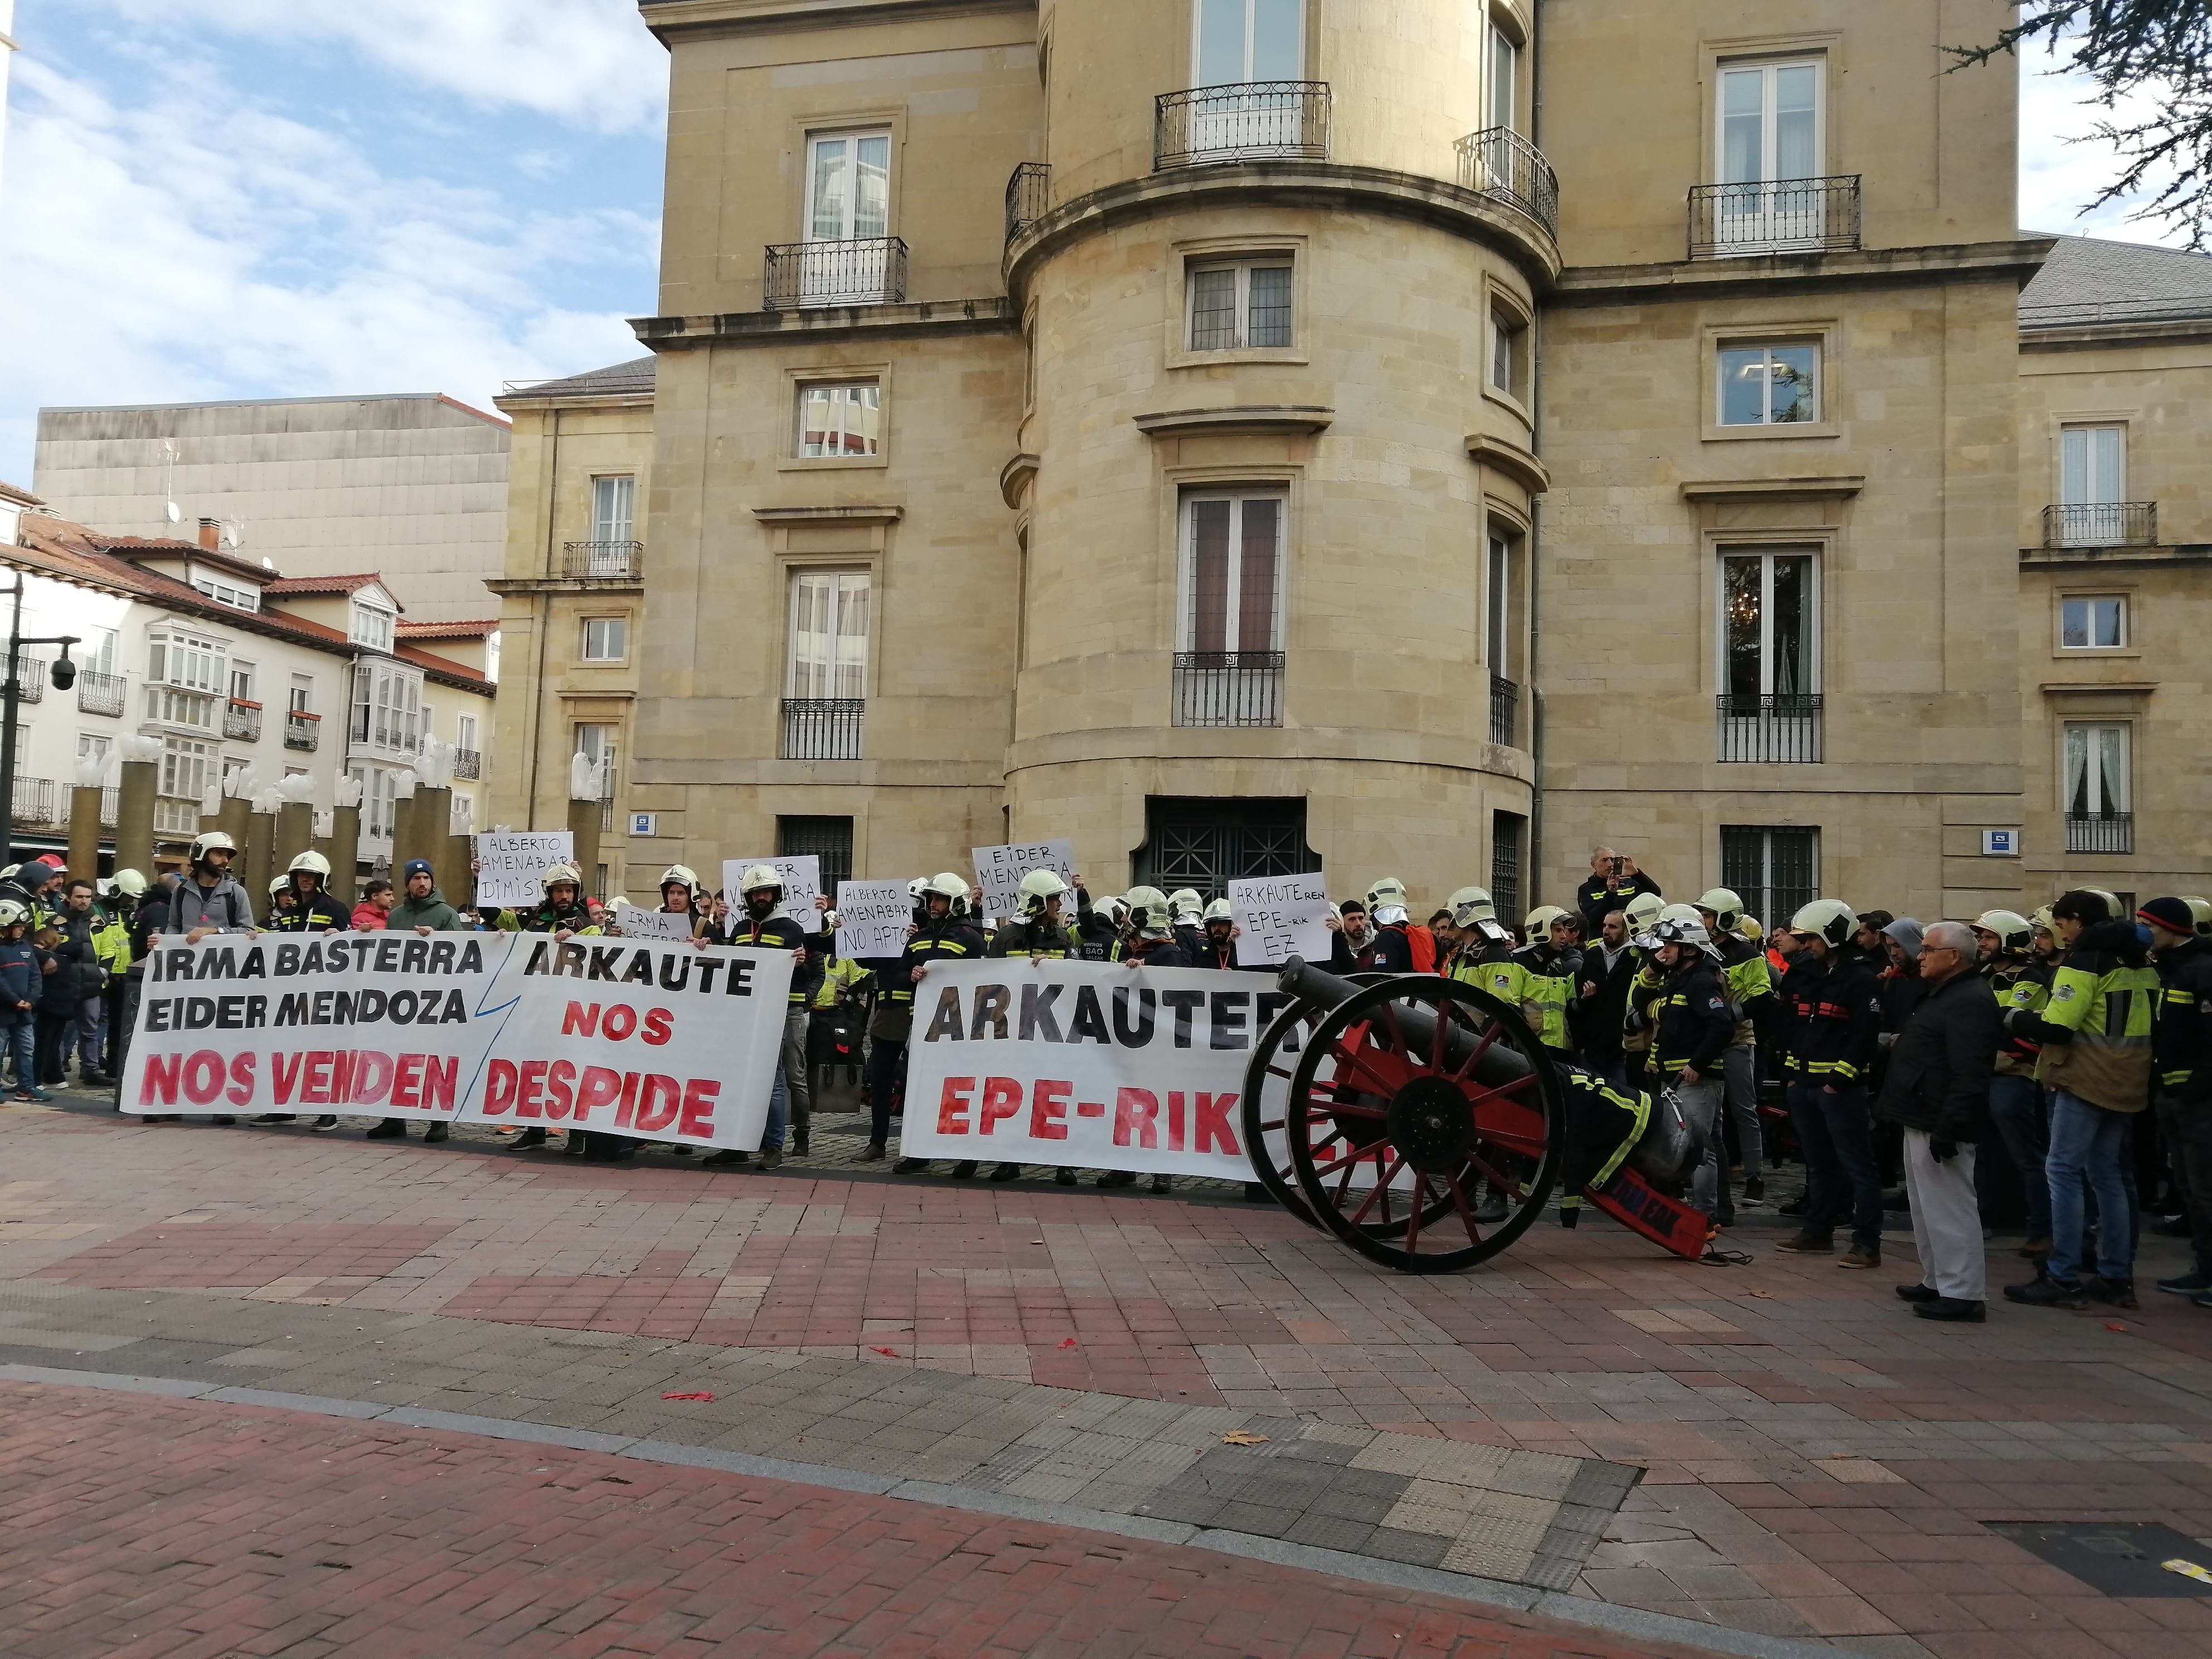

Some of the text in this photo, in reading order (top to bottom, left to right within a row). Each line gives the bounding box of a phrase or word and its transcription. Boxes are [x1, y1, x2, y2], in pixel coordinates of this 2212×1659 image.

[490, 838, 561, 851] ALBERTO
[482, 855, 569, 871] AMENABAR
[846, 887, 897, 901] ALBERTO
[628, 911, 669, 931] IRMA
[838, 904, 910, 923] AMENABAR
[843, 926, 908, 952] NO APTO
[1263, 934, 1299, 957] EZ
[152, 938, 483, 982] IRMA BASTERRA
[524, 939, 756, 997] ARKAUTE
[144, 988, 467, 1032] EIDER MENDOZA
[561, 1001, 675, 1045] NOS
[139, 1049, 459, 1111] NOS VENDEN
[483, 1059, 721, 1138] DESPIDE
[937, 1076, 1242, 1156] EPE-RIK
